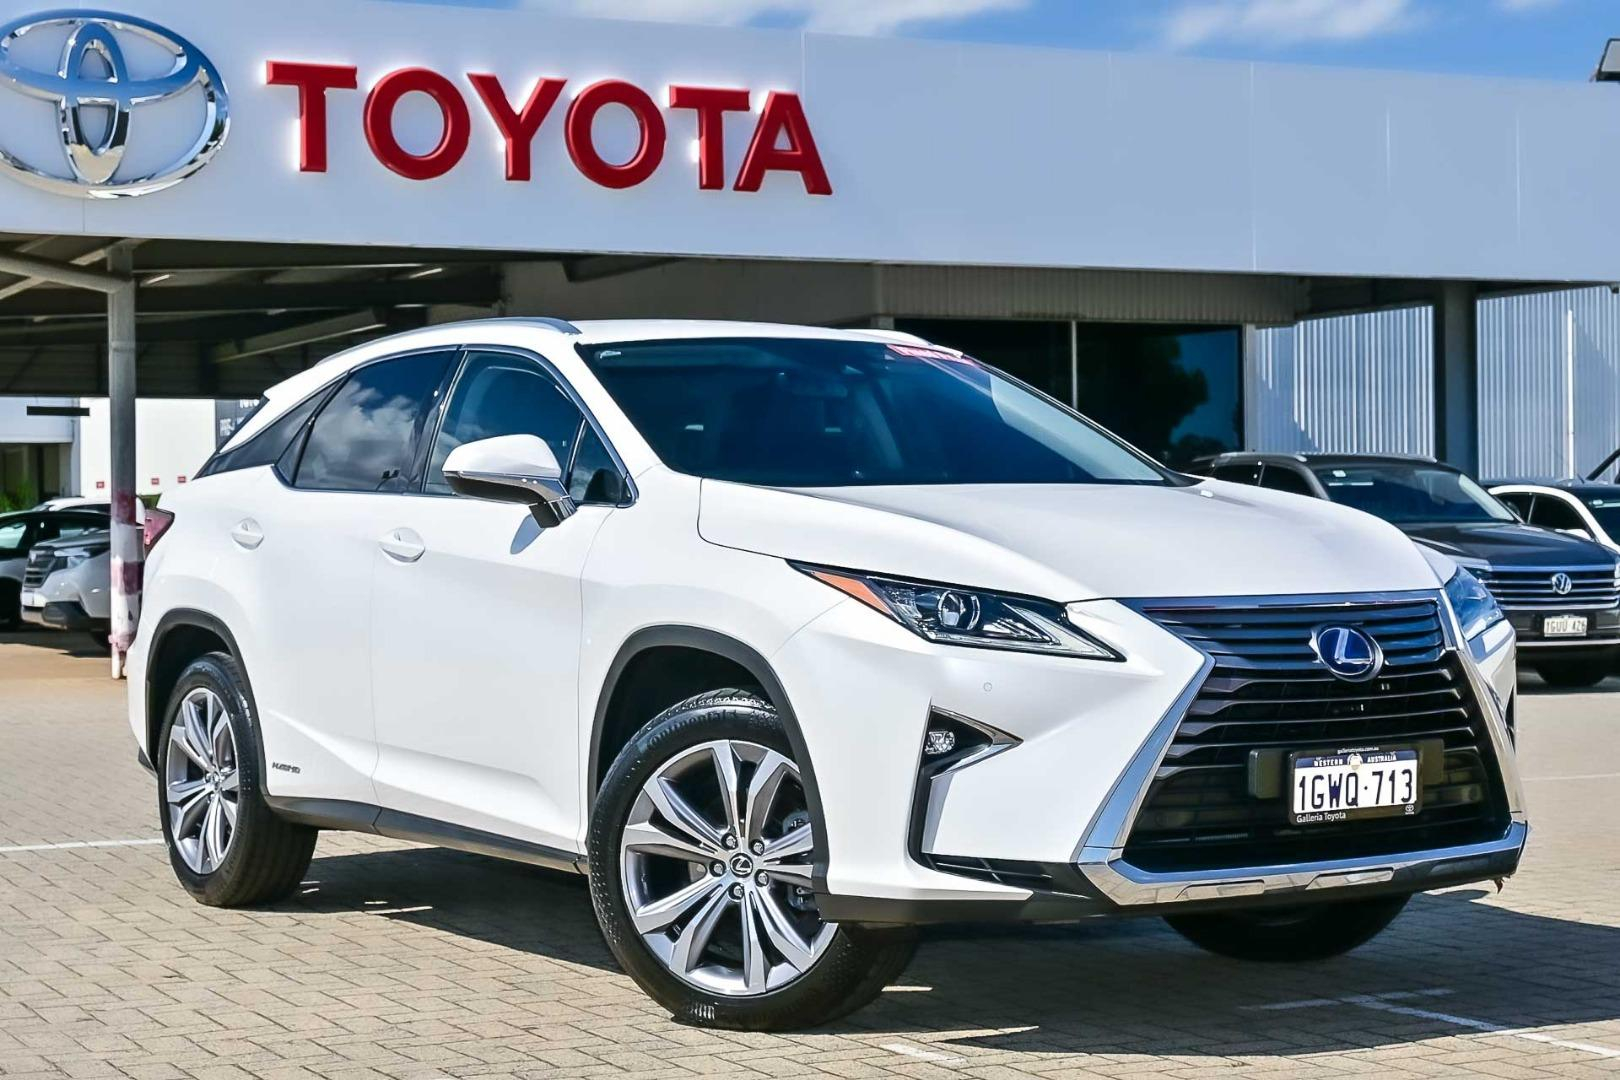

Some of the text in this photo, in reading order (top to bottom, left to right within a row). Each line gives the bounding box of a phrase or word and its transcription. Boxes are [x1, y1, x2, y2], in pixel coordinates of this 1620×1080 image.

[265, 59, 833, 196] TOYOTA
[1313, 754, 1397, 767] WESTERN AUSTRALIA
[1296, 811, 1346, 823] Galleria Toyota
